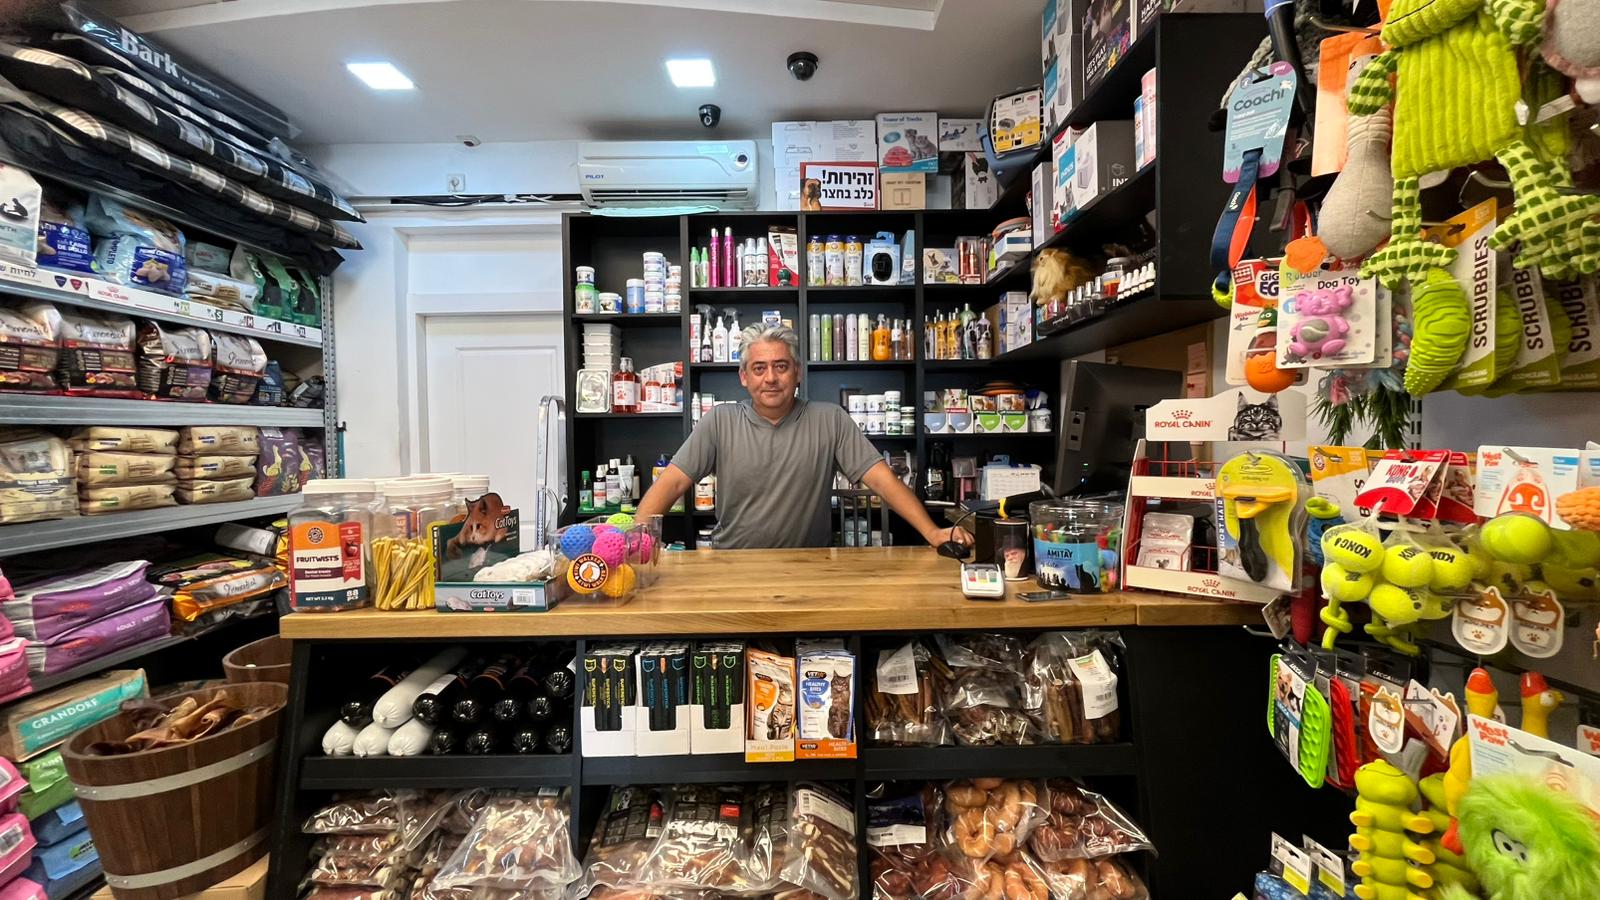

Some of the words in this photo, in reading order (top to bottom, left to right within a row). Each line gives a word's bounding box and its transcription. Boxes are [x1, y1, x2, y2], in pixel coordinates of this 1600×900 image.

[121, 27, 178, 78] Bark
[822, 170, 874, 185] זהירות!
[822, 188, 852, 199] בחצר
[854, 187, 874, 199] כלב
[1318, 280, 1339, 290] Dog
[1342, 276, 1361, 286] Toy
[1474, 235, 1489, 348] SCRUBBIES
[1482, 452, 1502, 460] West
[1386, 464, 1411, 476] KONG
[1217, 500, 1225, 519] HAIR
[296, 555, 340, 563] FRUITWISTS
[1047, 549, 1073, 559] AMITAY
[347, 589, 359, 597] 88
[1187, 586, 1209, 595] ROYAL
[1211, 588, 1236, 598] CANIN
[116, 621, 137, 632] ADULT
[32, 698, 99, 729] GRANDORF
[1472, 719, 1509, 740] West
[1479, 731, 1505, 747] Paw
